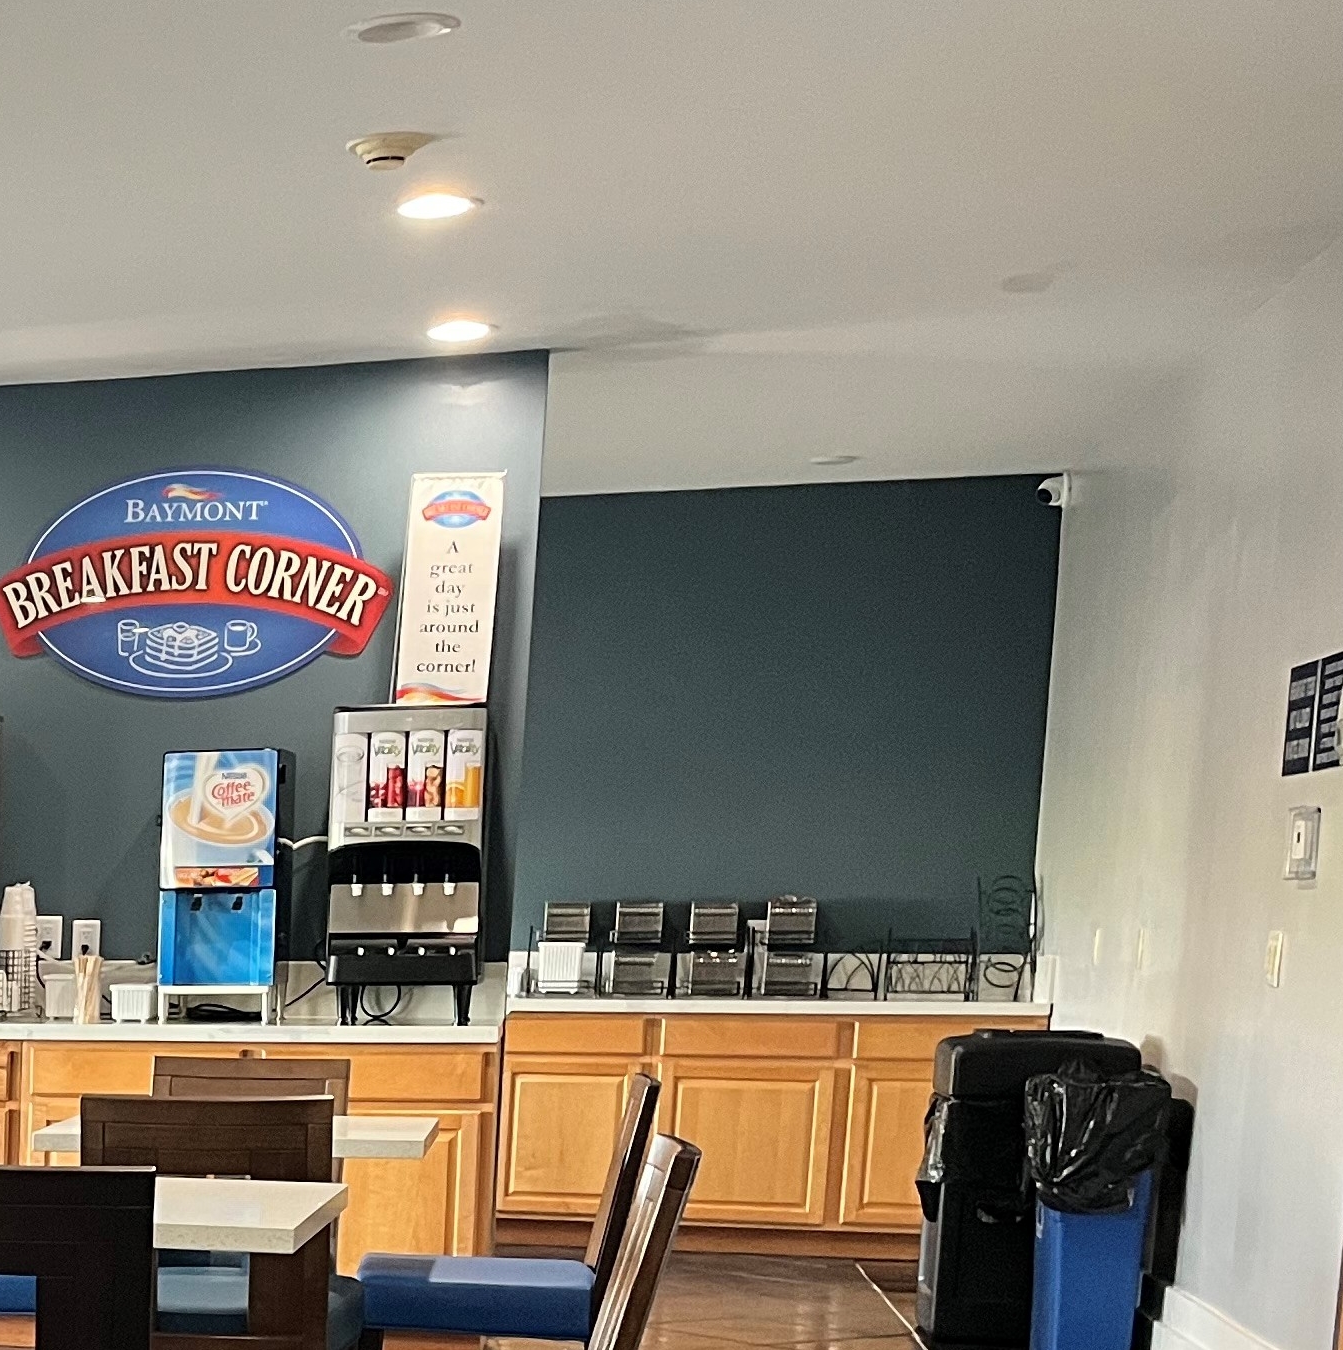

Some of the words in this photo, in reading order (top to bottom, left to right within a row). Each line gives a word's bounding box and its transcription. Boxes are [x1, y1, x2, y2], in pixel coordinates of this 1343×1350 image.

[124, 499, 265, 524] BAYMONT
[446, 540, 459, 554] A
[429, 563, 473, 578] great
[2, 542, 218, 629] BREAKFAST
[226, 544, 377, 627] CORNER
[435, 580, 465, 598] day
[426, 599, 440, 613] is
[445, 599, 476, 617] just
[419, 619, 479, 633] around
[435, 639, 461, 653] the
[416, 658, 476, 673] corner!
